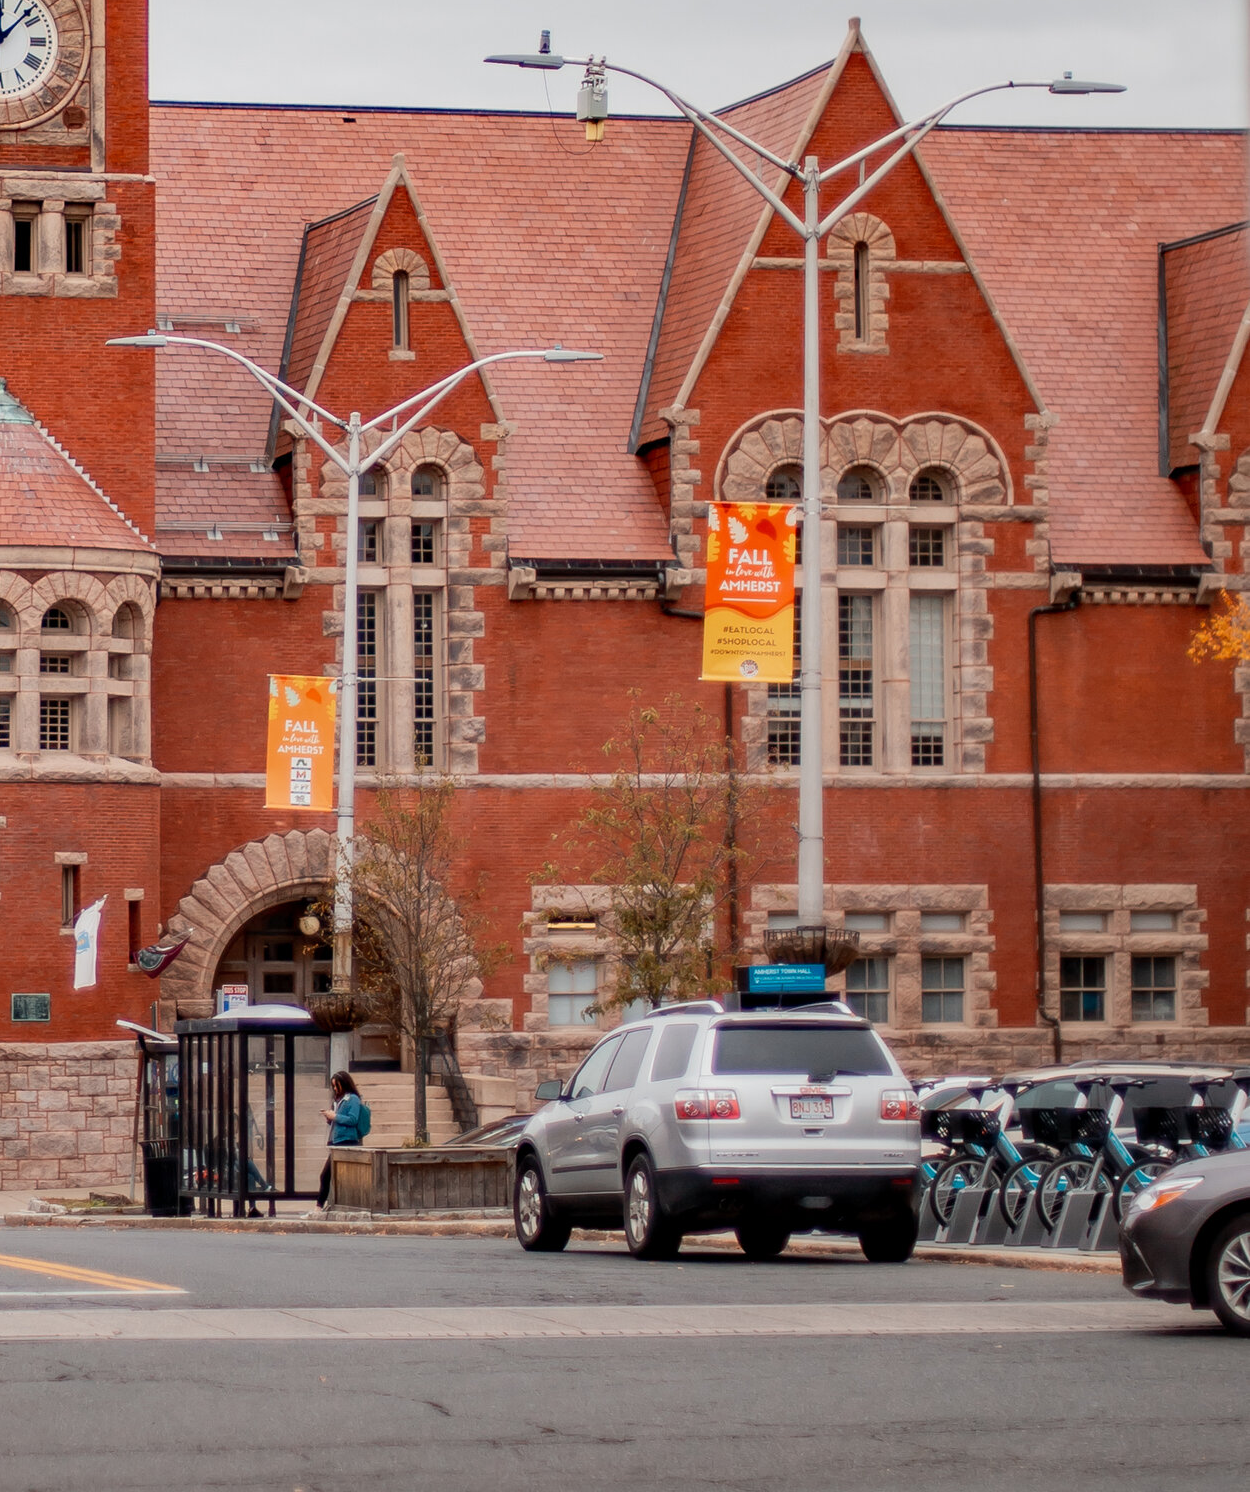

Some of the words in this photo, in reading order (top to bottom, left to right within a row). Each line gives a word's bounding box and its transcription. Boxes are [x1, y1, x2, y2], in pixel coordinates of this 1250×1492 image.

[728, 548, 773, 565] FALL
[725, 567, 735, 575] in
[735, 564, 753, 577] love
[754, 565, 776, 579] with
[718, 580, 781, 593] AMHERST
[723, 626, 775, 635] #EATLOCAL
[717, 638, 777, 646] #SHOPLOCAL
[710, 649, 786, 657] #DOWNTOWNAMHERST
[285, 719, 319, 733] FALL
[290, 733, 303, 743] love
[304, 734, 320, 744] with
[277, 744, 324, 755] AMHERST
